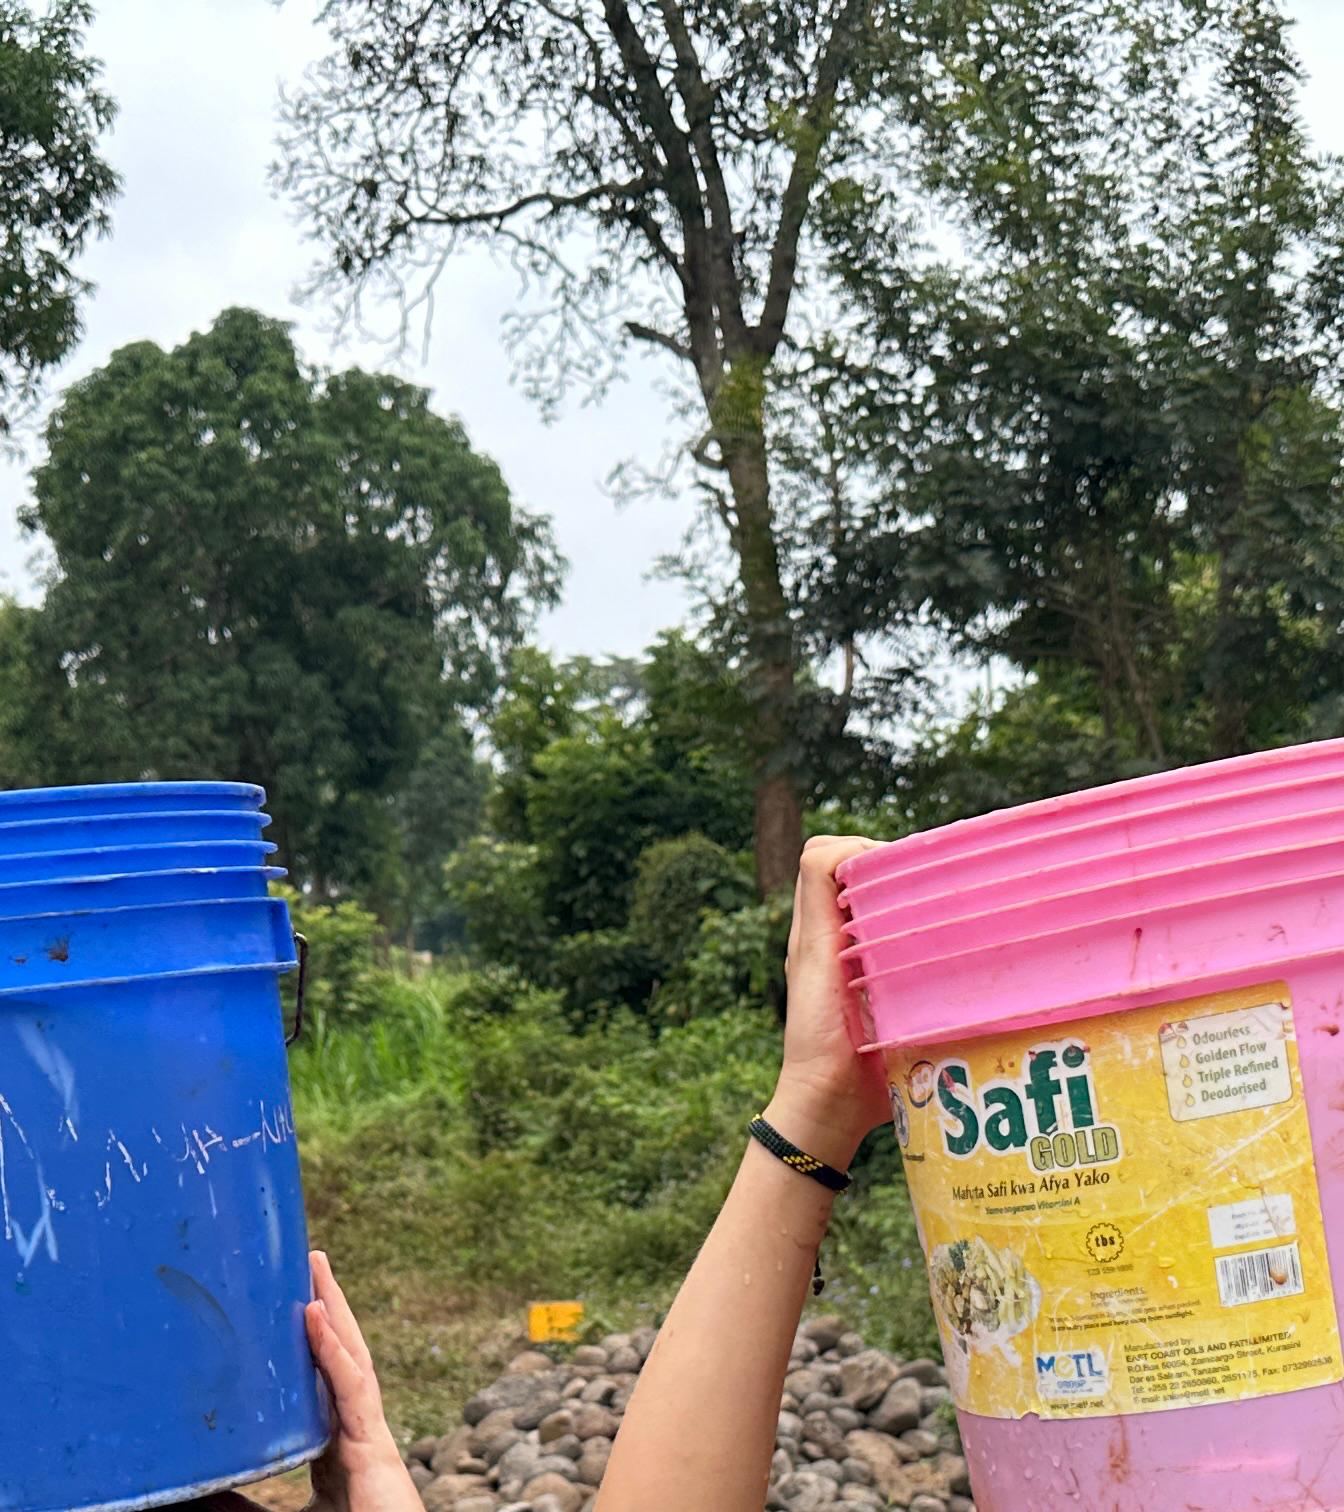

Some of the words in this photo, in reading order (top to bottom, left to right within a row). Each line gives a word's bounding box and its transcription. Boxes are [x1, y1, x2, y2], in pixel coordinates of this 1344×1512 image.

[1192, 1026, 1250, 1046] Odourless
[1195, 1048, 1238, 1064] Golden
[1239, 1041, 1267, 1057] Flow
[1197, 1066, 1231, 1084] Triple
[1233, 1056, 1279, 1077] Refined
[937, 1044, 1095, 1156] Safi
[1201, 1079, 1267, 1102] Deodorised
[1029, 1126, 1120, 1171] GOLD
[987, 1179, 1007, 1198] Safi
[1010, 1180, 1035, 1196] kwa
[1039, 1175, 1070, 1194] Afya
[1074, 1168, 1110, 1187] Yako
[1094, 1234, 1116, 1247] tbs
[1150, 1348, 1182, 1360] COAST
[1183, 1345, 1205, 1356] OILS
[1206, 1342, 1227, 1352] AND
[1157, 1371, 1191, 1381] Salam,
